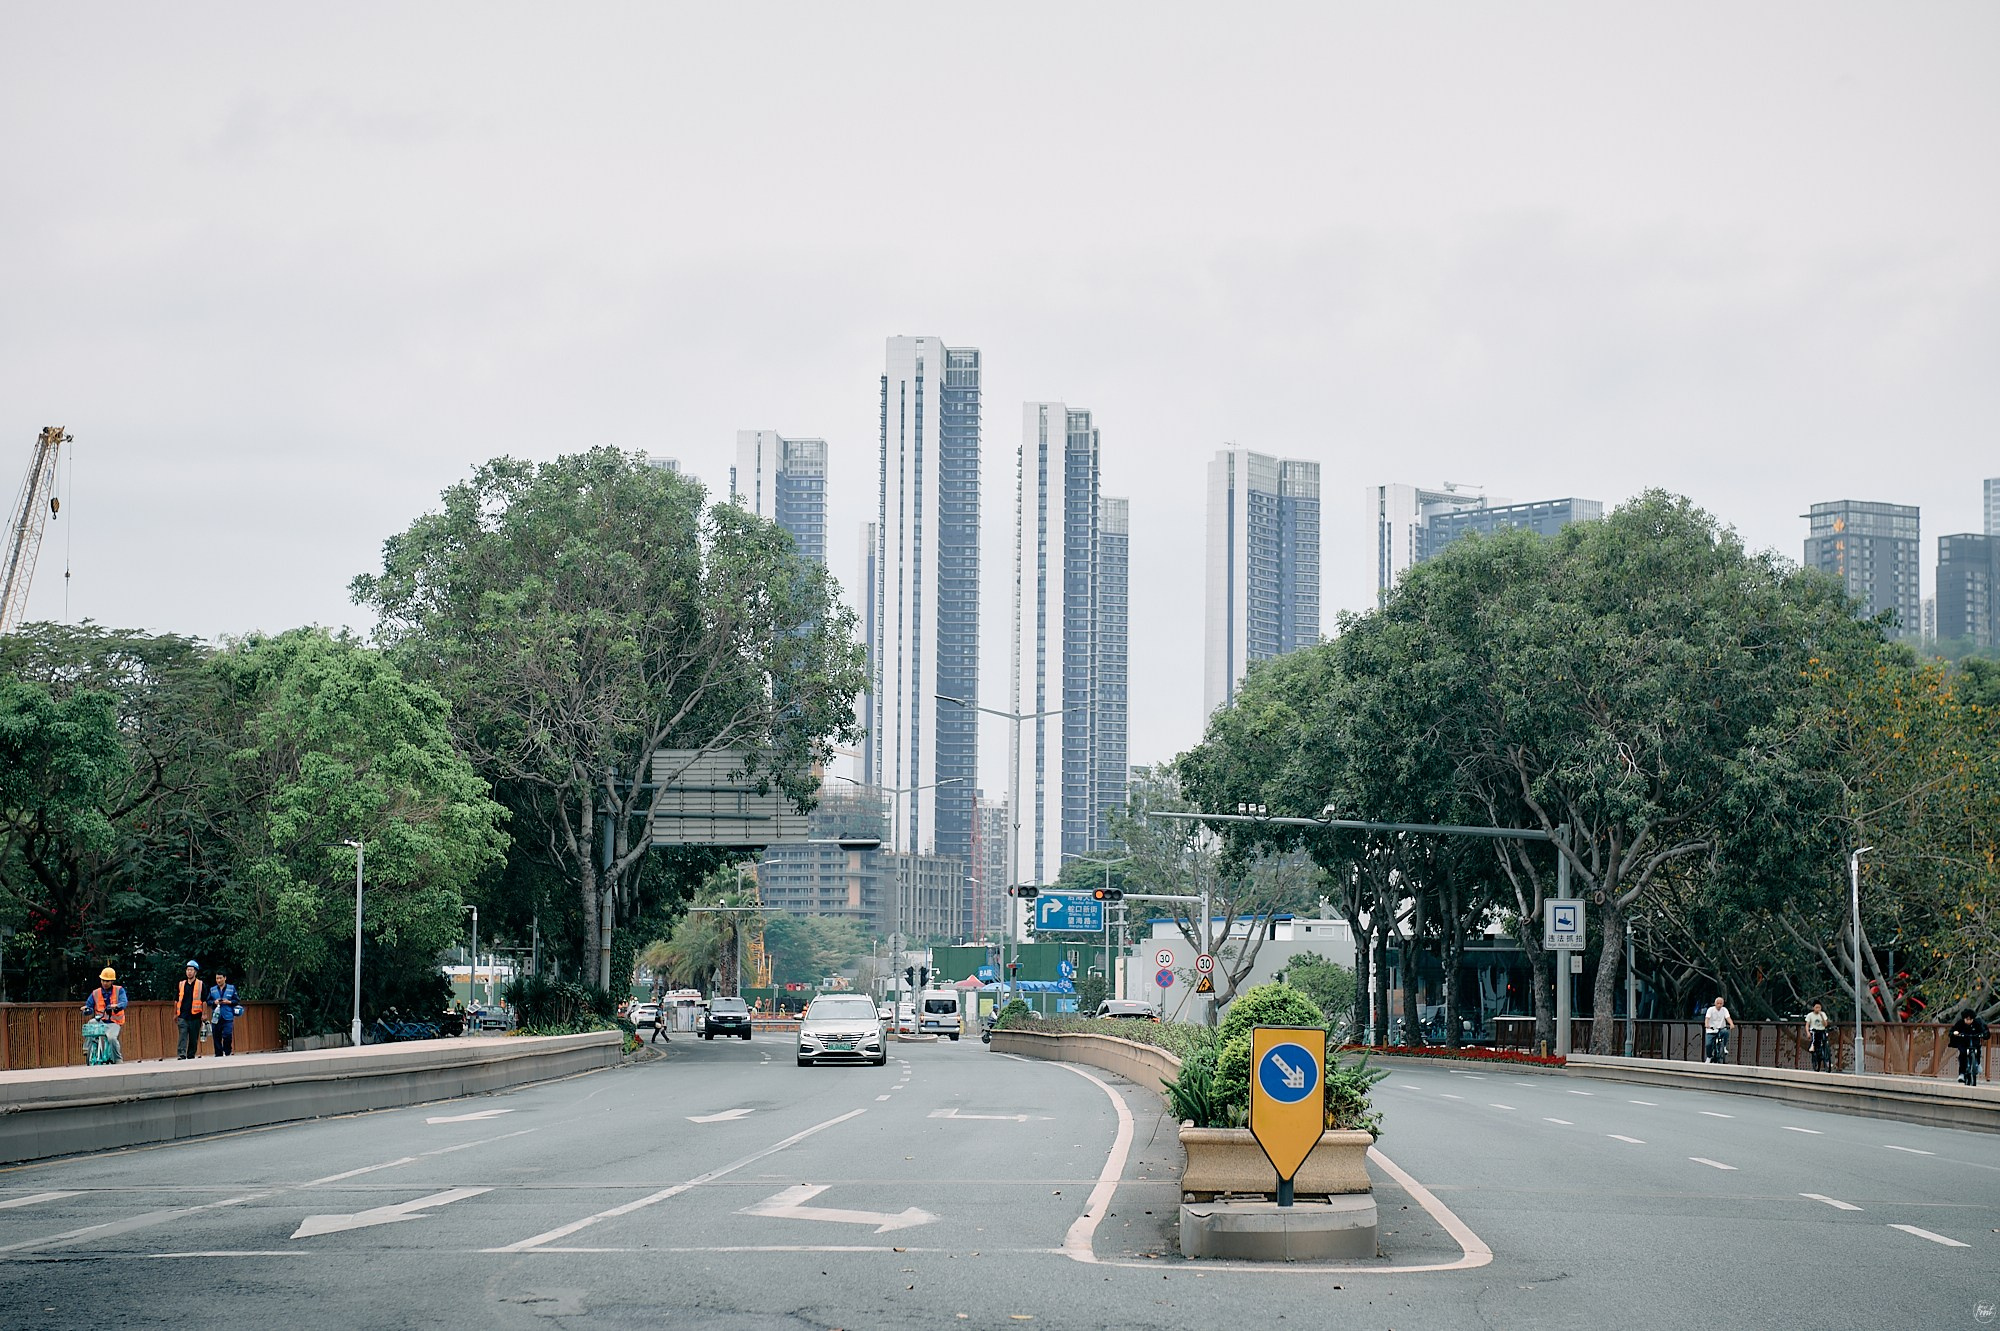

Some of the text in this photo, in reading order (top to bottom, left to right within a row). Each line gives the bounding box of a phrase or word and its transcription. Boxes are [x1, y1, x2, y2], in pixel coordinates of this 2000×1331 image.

[1548, 934, 1582, 942] 违法抓拍
[1160, 954, 1170, 963] 30
[1200, 959, 1210, 969] 30
